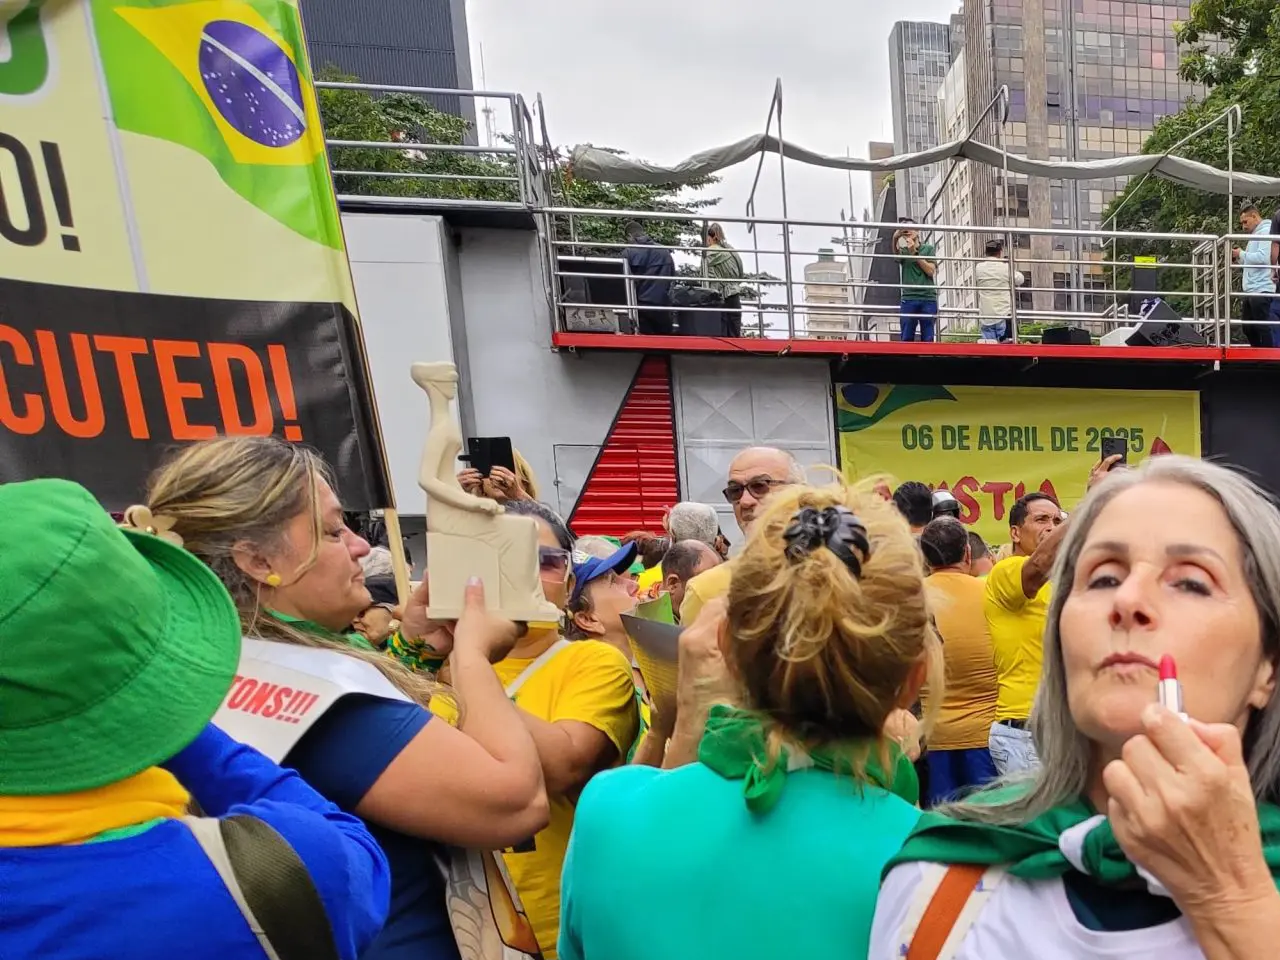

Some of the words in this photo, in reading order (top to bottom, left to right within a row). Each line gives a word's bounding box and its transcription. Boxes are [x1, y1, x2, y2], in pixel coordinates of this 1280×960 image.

[901, 423, 933, 450] 06
[940, 424, 970, 451] DE
[977, 424, 1044, 451] ABRIL
[1050, 426, 1079, 452] DE
